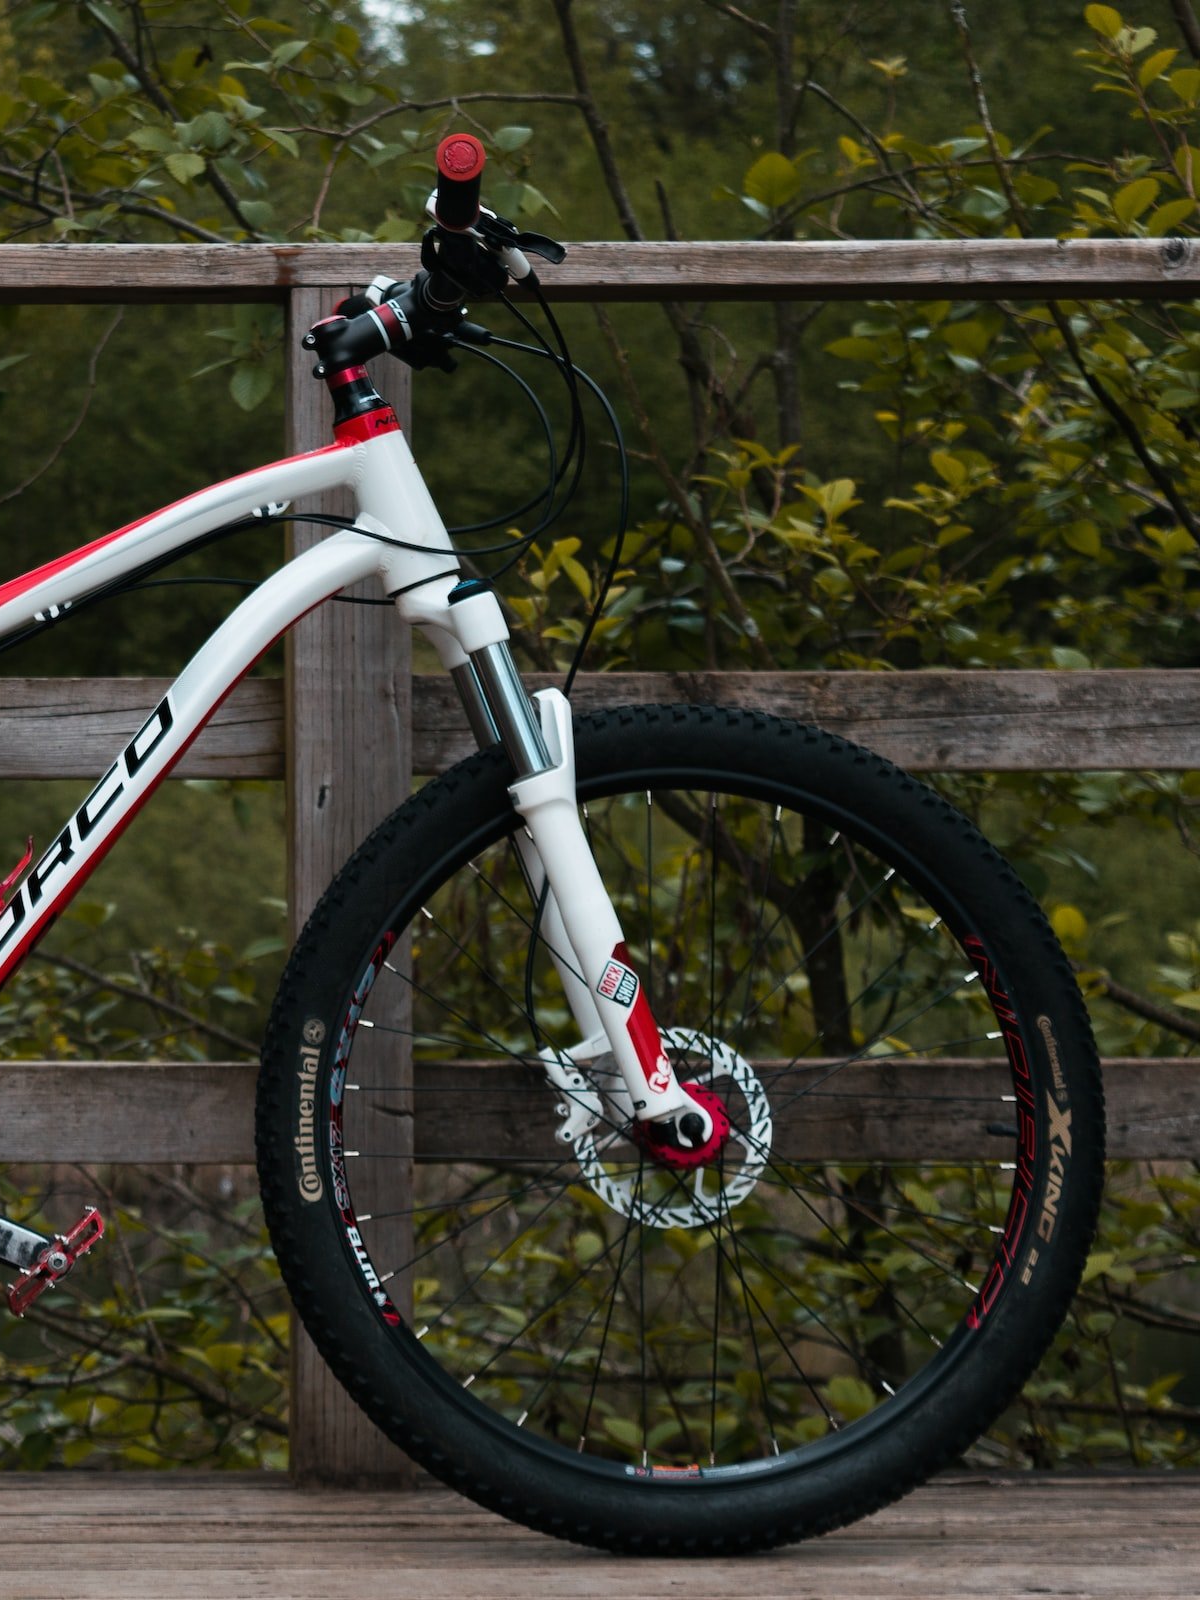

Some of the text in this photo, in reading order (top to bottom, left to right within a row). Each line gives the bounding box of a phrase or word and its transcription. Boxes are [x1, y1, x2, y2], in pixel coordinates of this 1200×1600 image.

[600, 965, 623, 996] ROCK
[615, 972, 637, 1004] SHOX
[293, 1045, 324, 1203] Continental
[347, 1226, 381, 1289] WTB
